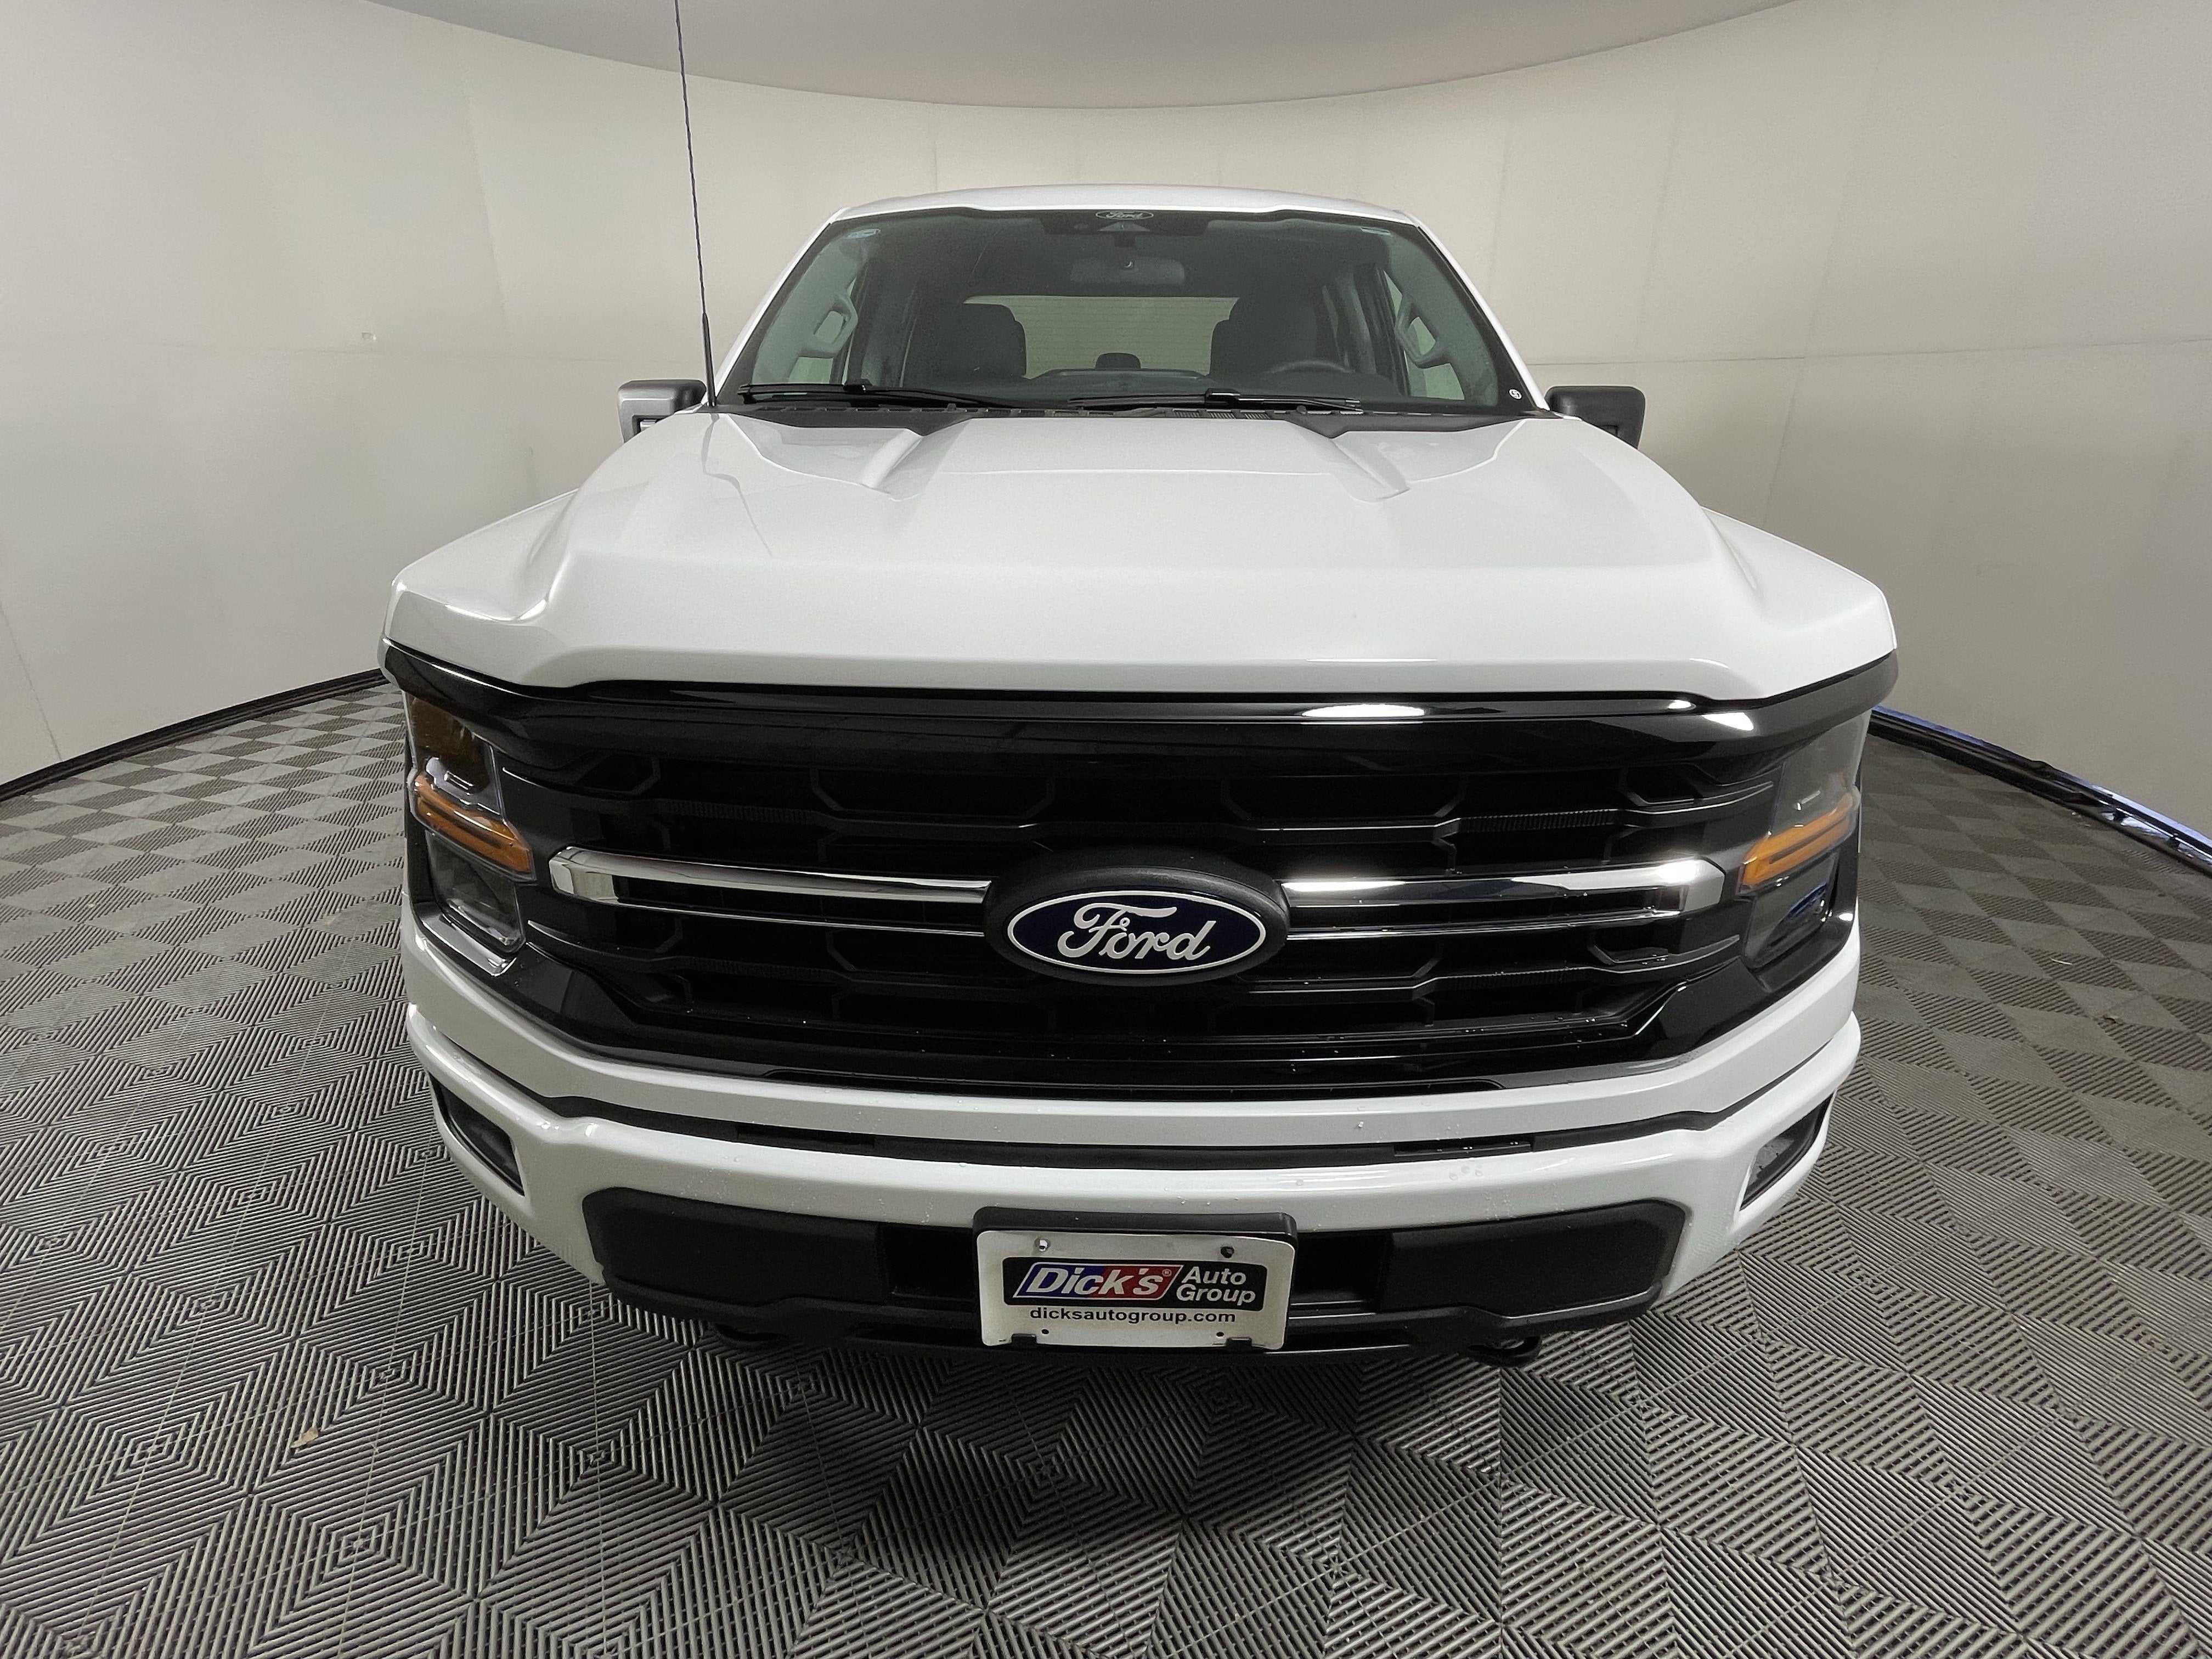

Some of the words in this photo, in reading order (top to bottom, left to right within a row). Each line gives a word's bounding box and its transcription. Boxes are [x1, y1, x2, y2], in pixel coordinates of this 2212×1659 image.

[1057, 902, 1216, 960] Ford
[1025, 1267, 1163, 1296] Dick's
[1182, 1266, 1246, 1285] Auto
[1176, 1284, 1256, 1306] Group
[1030, 1307, 1236, 1324] dicksautogroup.com
